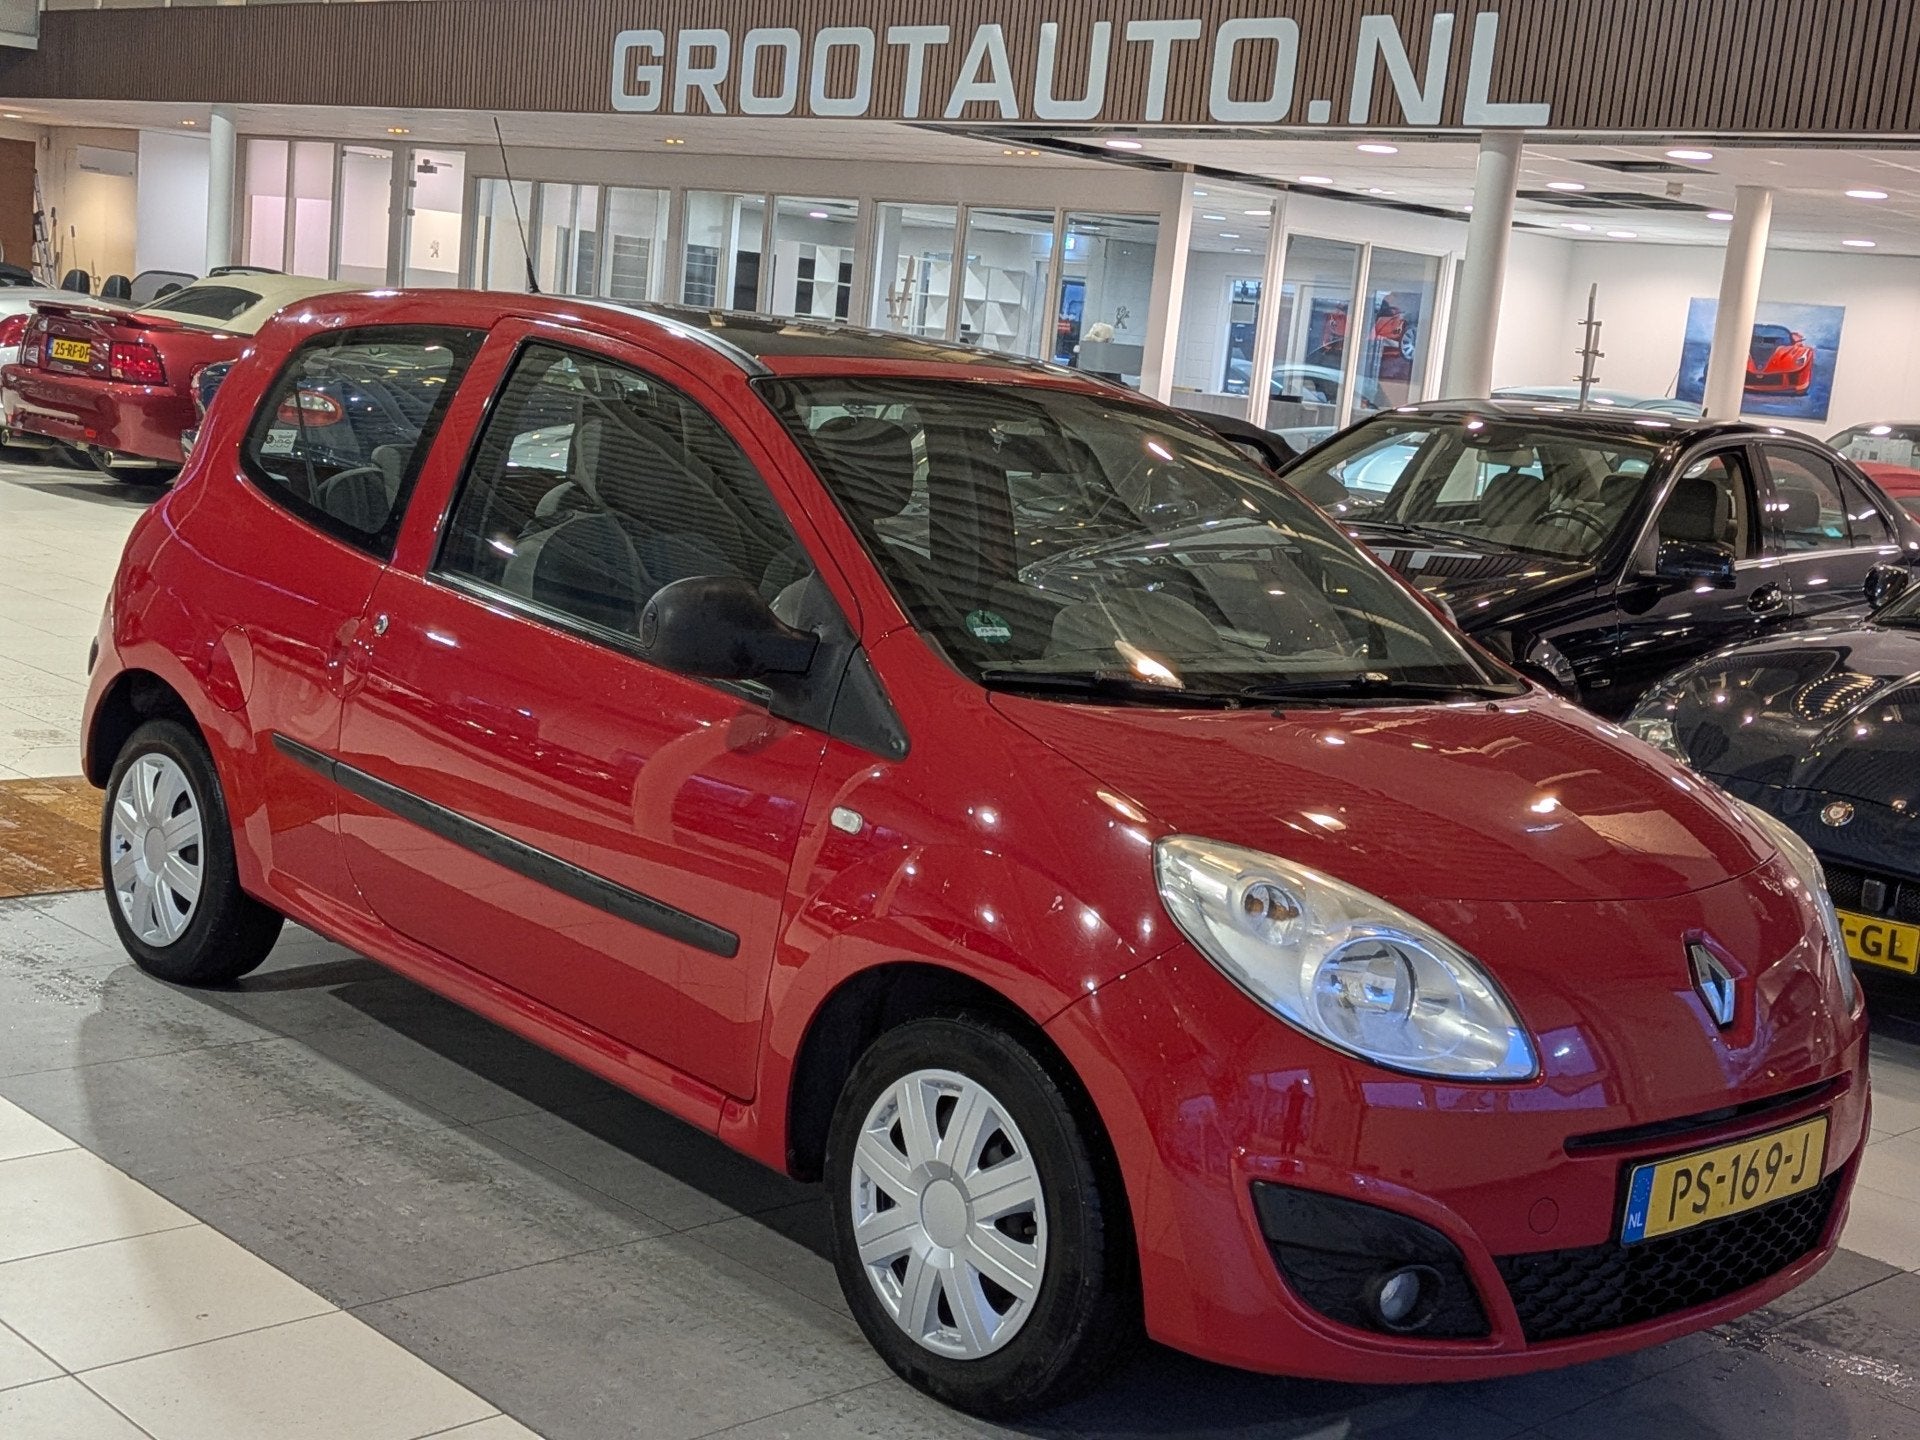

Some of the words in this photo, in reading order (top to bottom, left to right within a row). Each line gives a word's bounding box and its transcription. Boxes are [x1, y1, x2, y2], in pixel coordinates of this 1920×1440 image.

[610, 11, 1551, 127] GROOTAUTO.NL
[1838, 917, 1909, 965] -GL
[1668, 1132, 1810, 1222] PS-169-J
[1627, 1212, 1643, 1230] NL
